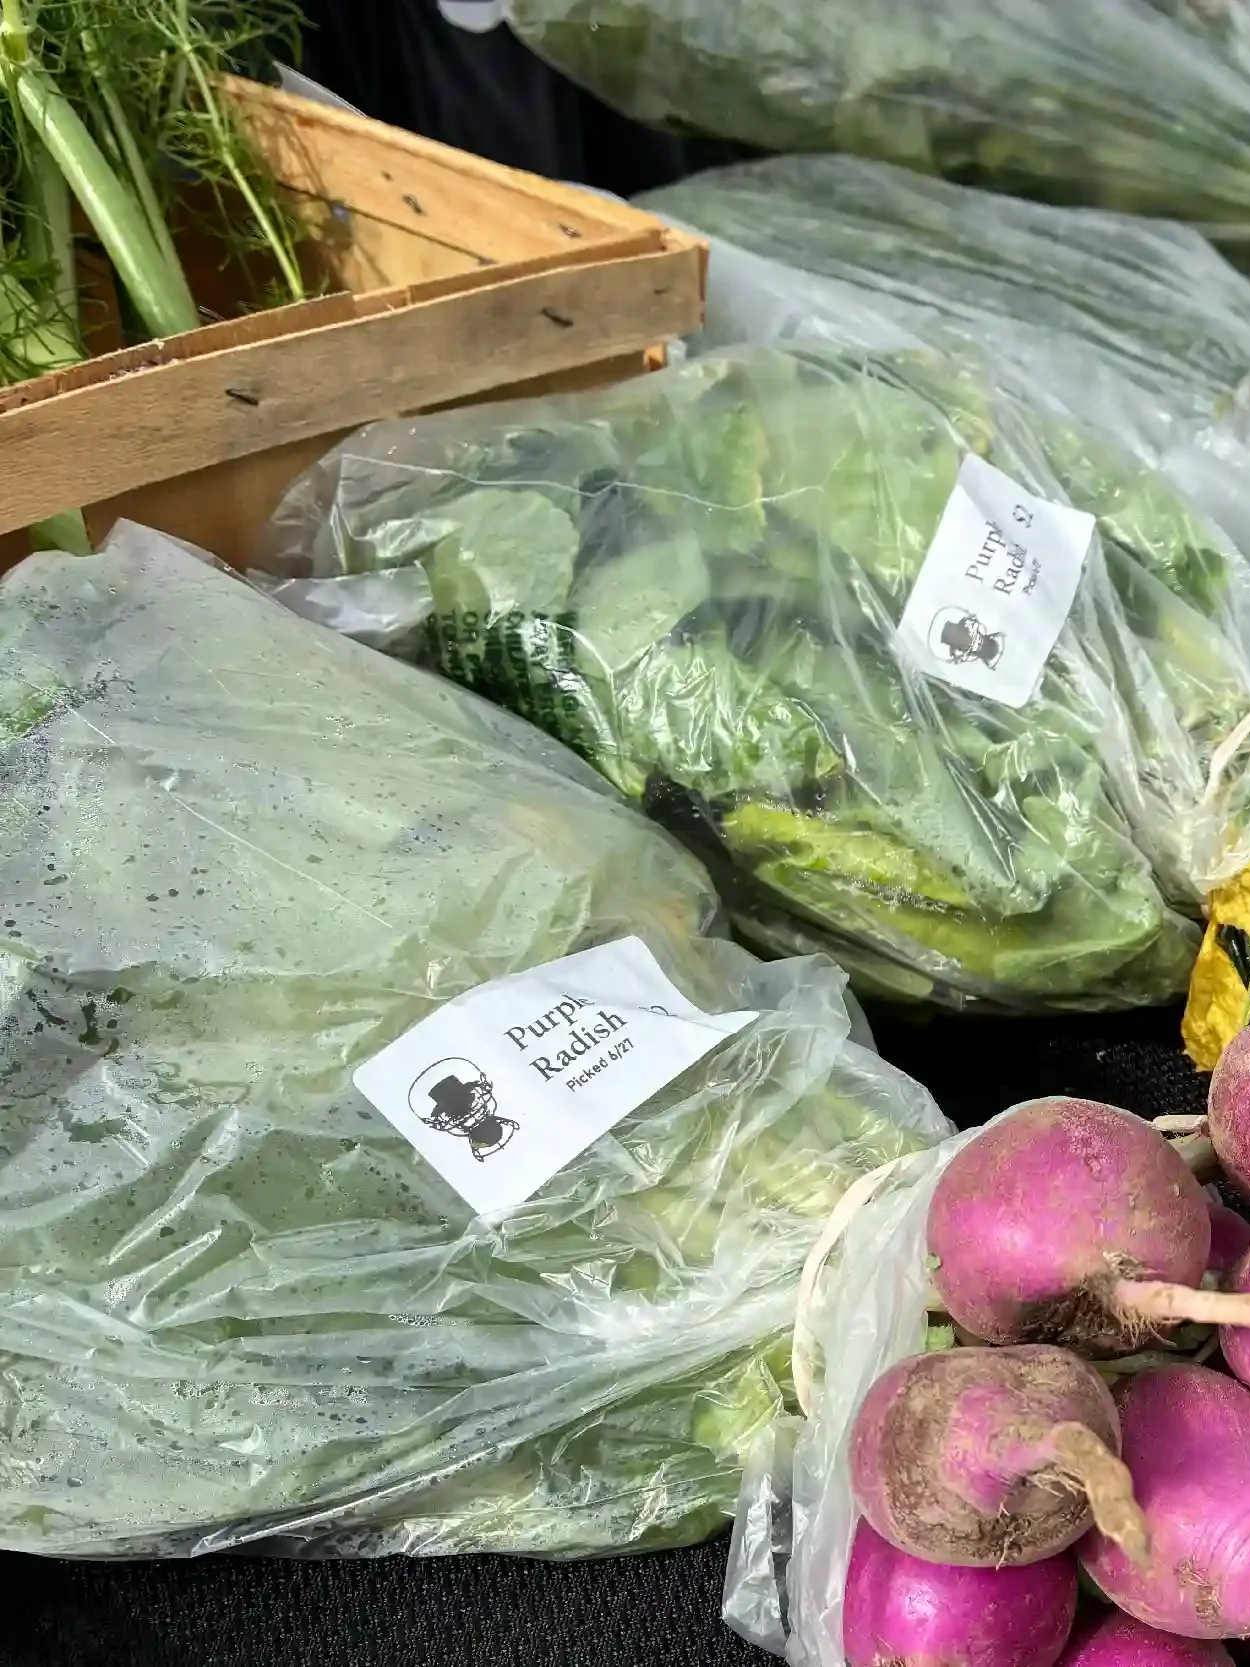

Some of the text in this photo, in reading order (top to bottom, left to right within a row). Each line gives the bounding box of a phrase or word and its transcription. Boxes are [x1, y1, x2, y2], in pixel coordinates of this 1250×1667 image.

[965, 519, 1006, 584] Purpl
[529, 1010, 629, 1083] Radish
[565, 1037, 635, 1092] Picked 6/27
